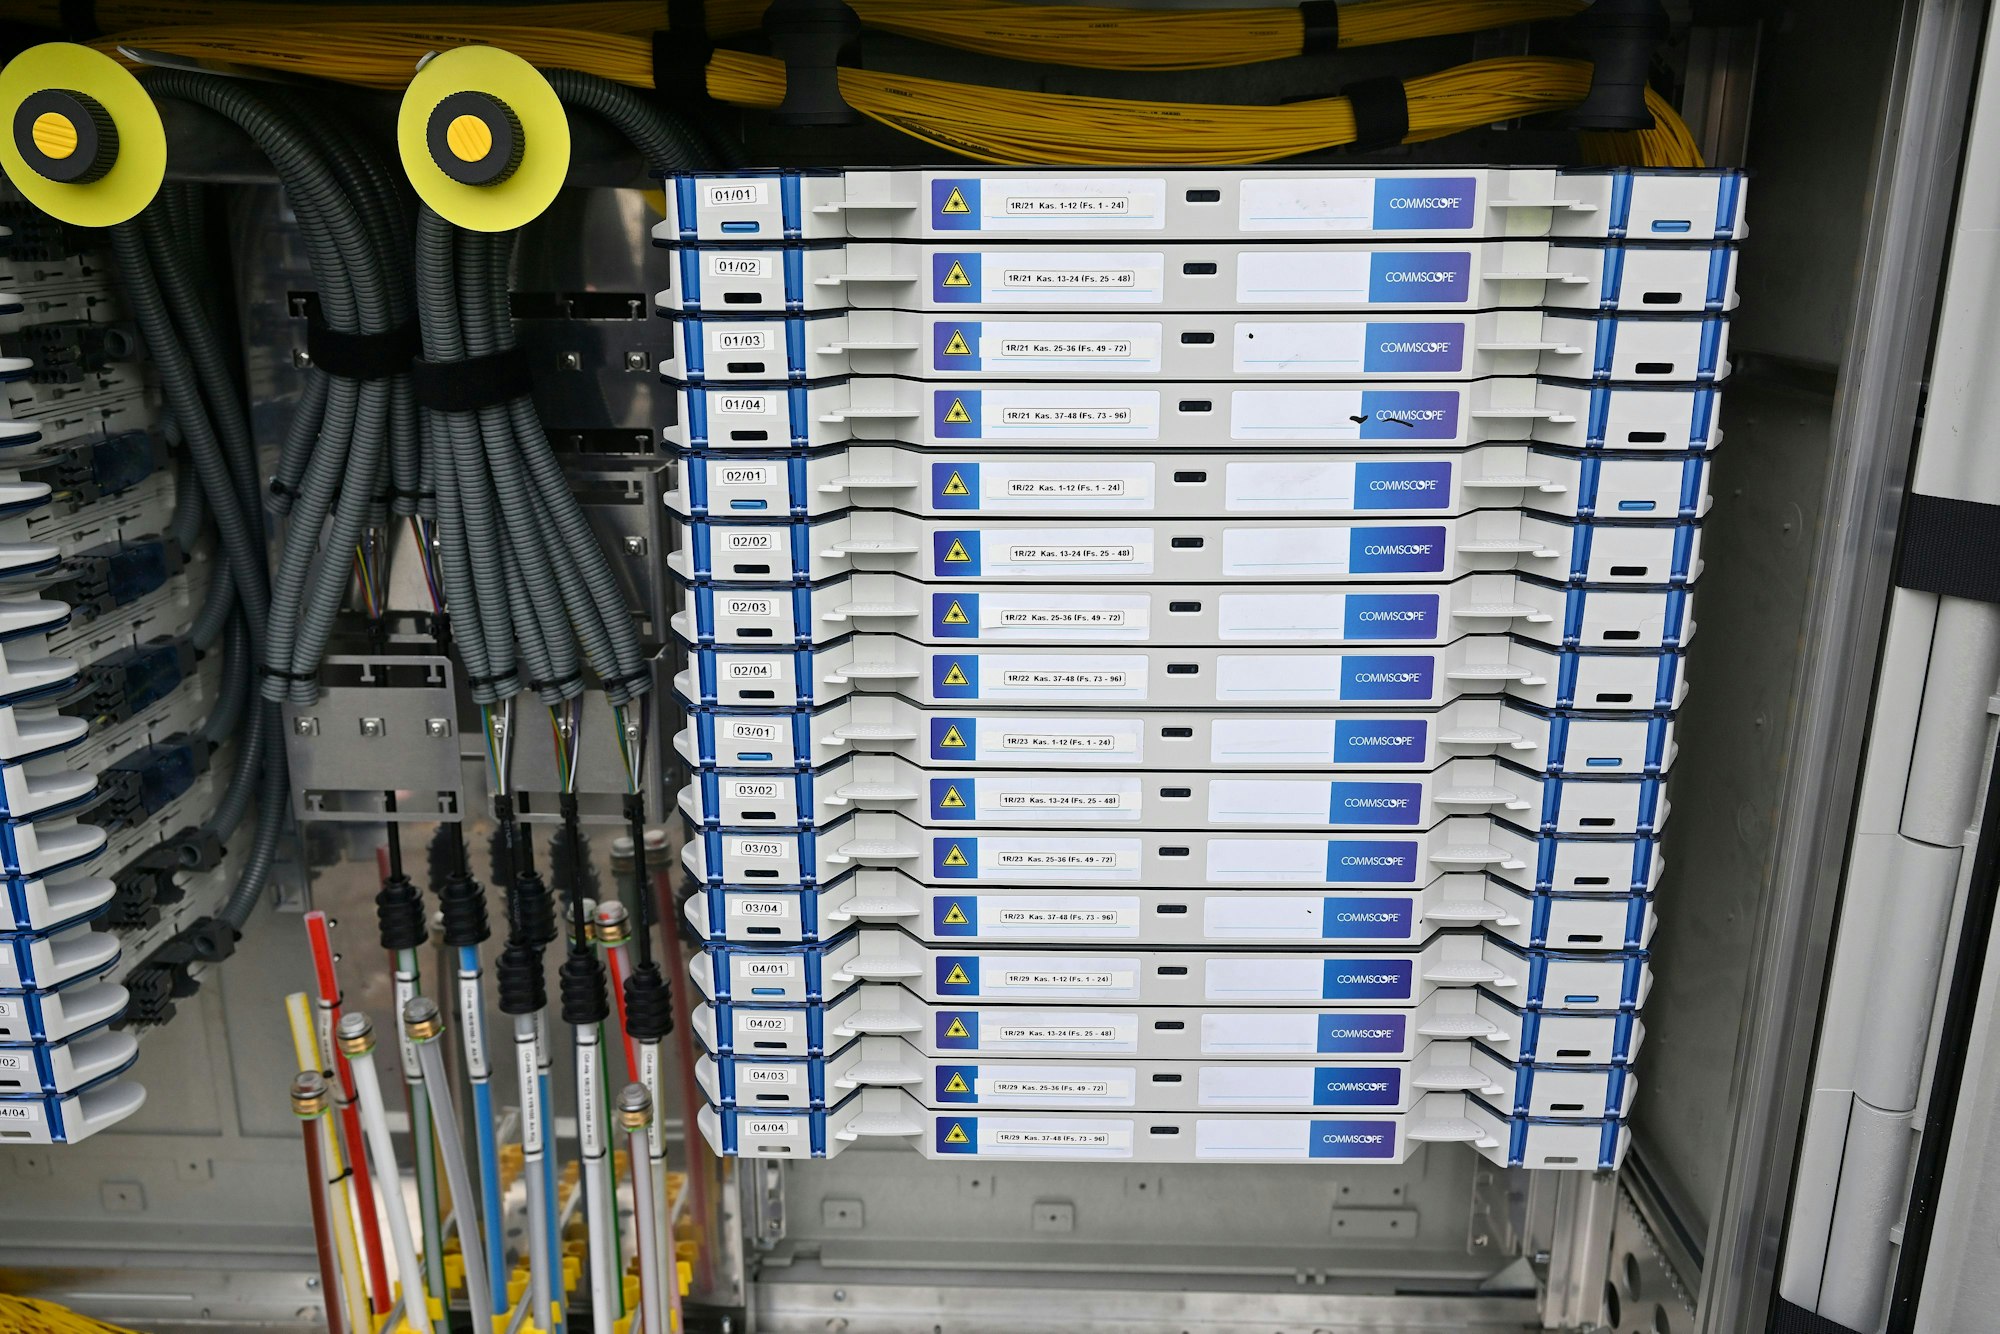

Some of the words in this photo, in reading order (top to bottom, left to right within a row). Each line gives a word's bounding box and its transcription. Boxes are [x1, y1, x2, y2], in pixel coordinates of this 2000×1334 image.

[714, 188, 750, 202] 01/01
[1079, 201, 1095, 209] (Fs.
[1111, 201, 1124, 209] 24)
[718, 262, 756, 272] 01/02
[1081, 274, 1098, 282] (Fs.
[1117, 274, 1131, 282] 48)
[724, 336, 760, 346] 01/03
[1114, 344, 1127, 352] 72)
[726, 400, 760, 410] 01/04
[1079, 411, 1094, 419] (Fs.
[1114, 411, 1127, 419] 96)
[726, 472, 760, 482] 02/01
[1077, 483, 1093, 491] (Fs.
[1107, 483, 1120, 491] 24)
[732, 536, 768, 546] 02/02
[732, 600, 768, 612] 02/03
[732, 664, 768, 676] 02/04
[736, 726, 772, 738] 03/01
[738, 786, 772, 796] 03/02
[744, 842, 780, 854] 03/03
[746, 902, 780, 912] 03/04
[752, 964, 784, 974] 04/01
[750, 1018, 782, 1030] 04/02
[752, 1070, 786, 1080] 04/03
[0, 1108, 25, 1117] 4/04
[752, 1122, 784, 1132] 04/04
